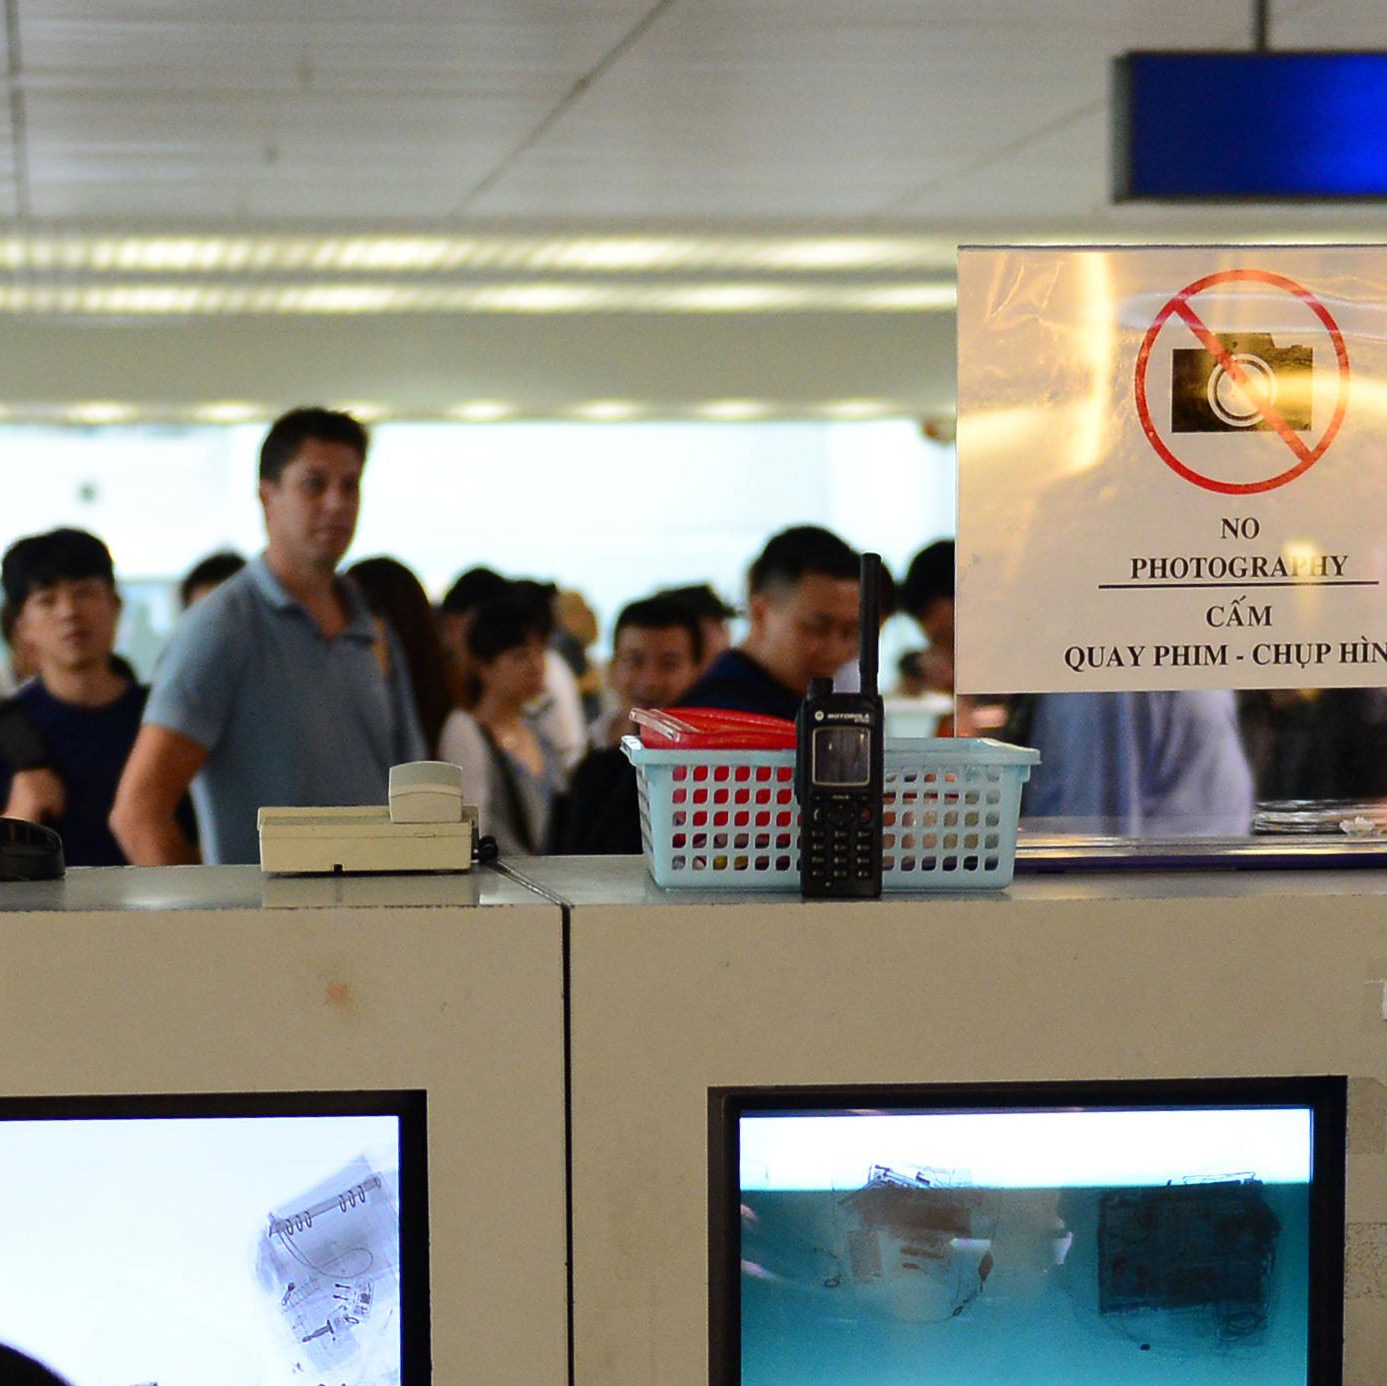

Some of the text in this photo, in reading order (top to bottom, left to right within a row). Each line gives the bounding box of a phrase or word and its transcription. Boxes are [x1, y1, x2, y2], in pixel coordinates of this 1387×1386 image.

[1221, 517, 1260, 539] NO
[1131, 555, 1348, 580] PHOTOGRAPHY
[1206, 595, 1273, 628] CẤM
[1065, 645, 1146, 672] QUAY
[1153, 645, 1228, 668] PHIM
[1253, 643, 1331, 672] CHỤP
